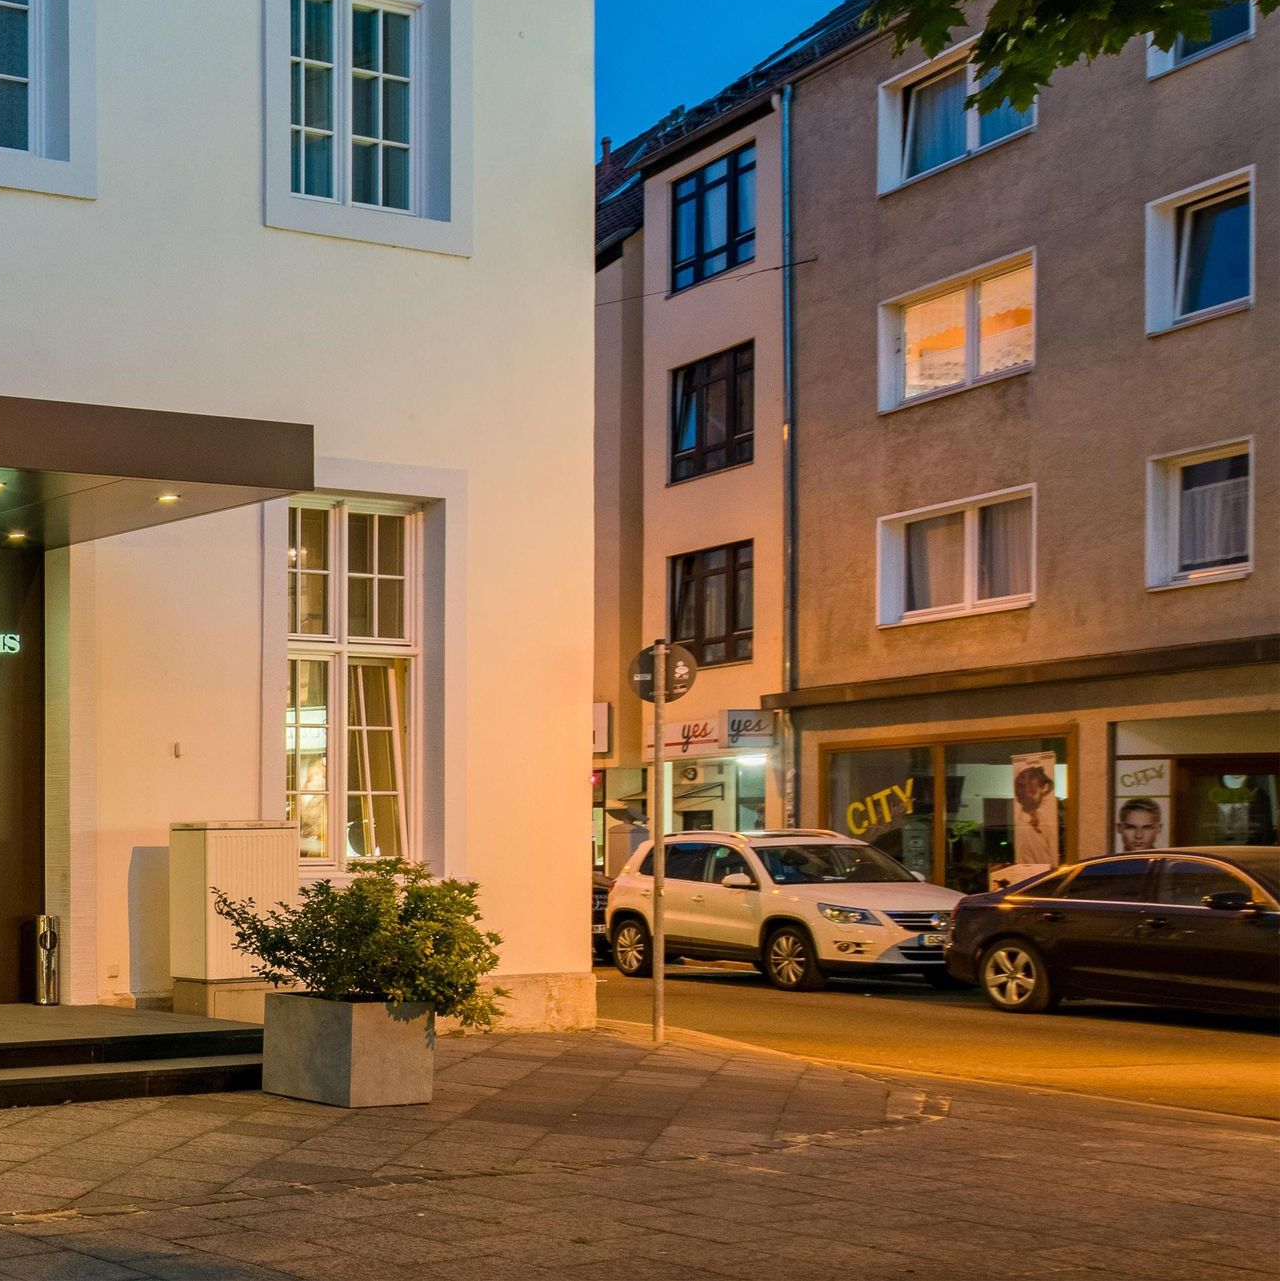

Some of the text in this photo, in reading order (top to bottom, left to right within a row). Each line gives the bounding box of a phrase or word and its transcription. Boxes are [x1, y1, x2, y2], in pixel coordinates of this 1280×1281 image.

[681, 722, 714, 753] yes
[730, 719, 769, 744] yes
[846, 777, 914, 836] CITY
